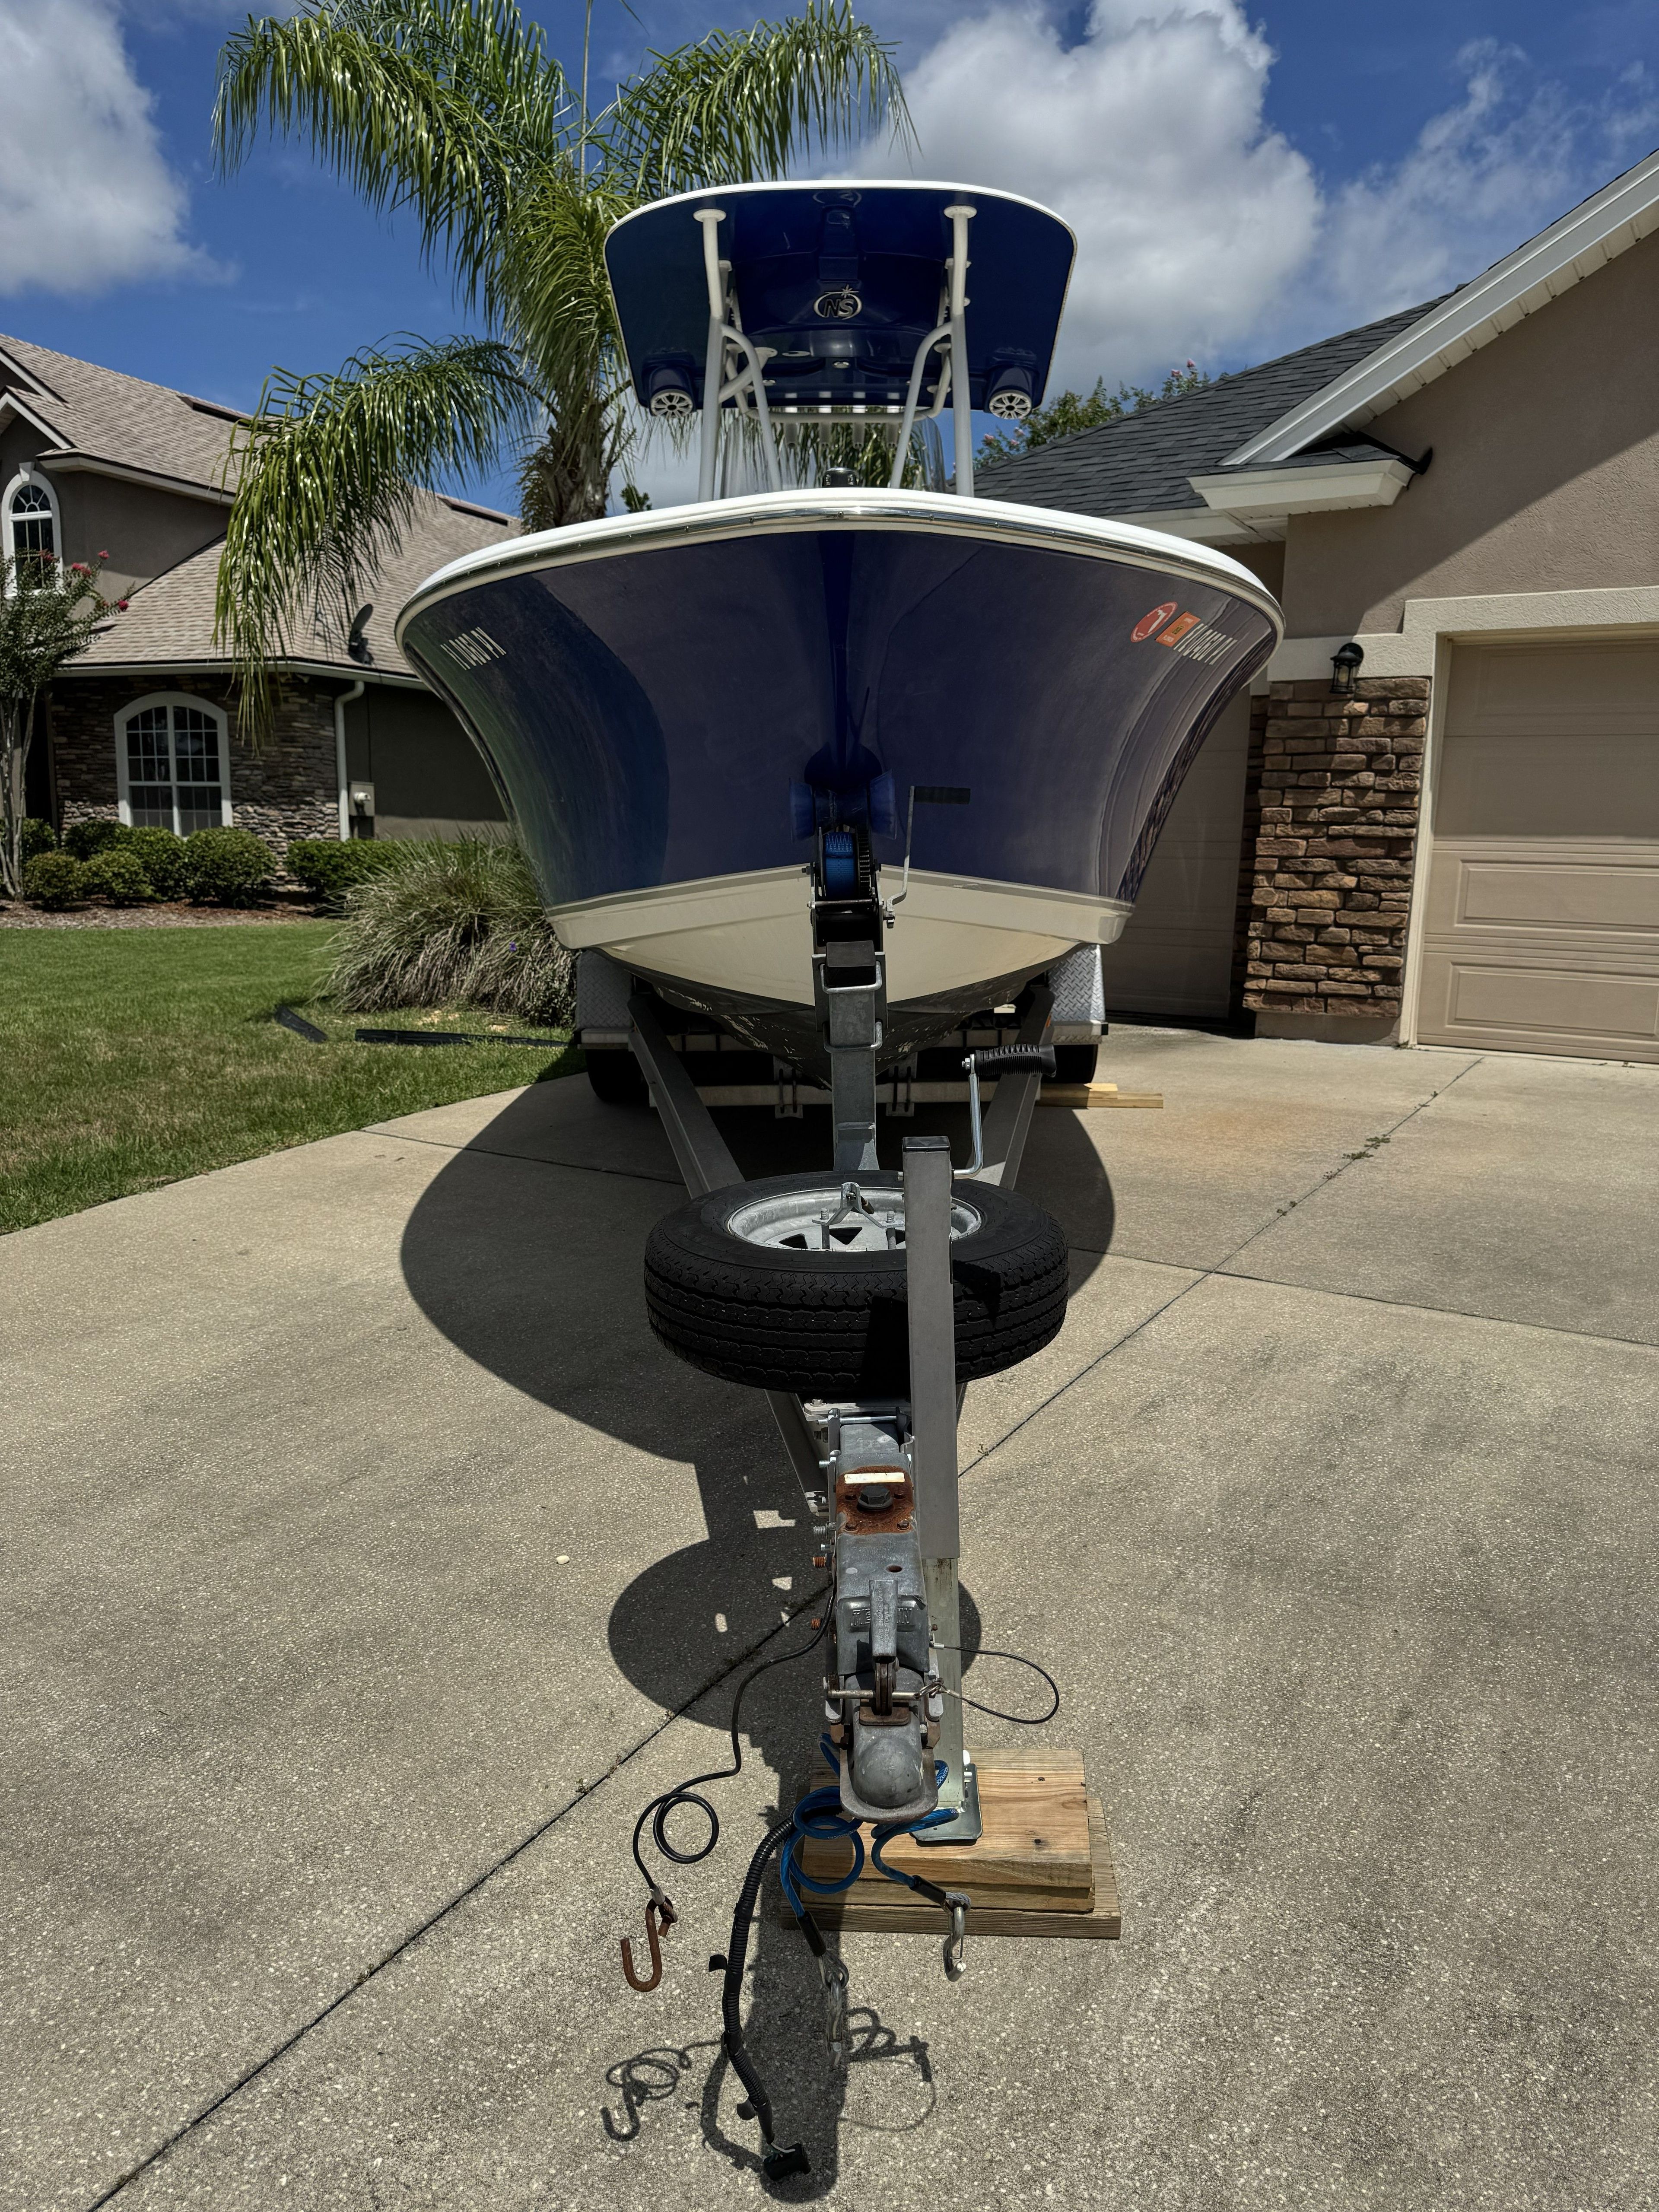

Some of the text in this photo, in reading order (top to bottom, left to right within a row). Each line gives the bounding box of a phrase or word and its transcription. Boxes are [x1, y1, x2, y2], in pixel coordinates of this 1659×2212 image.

[823, 299, 854, 318] NS
[448, 633, 492, 666] 0460
[1173, 623, 1208, 652] FL
[1182, 629, 1227, 661] 0460
[440, 643, 471, 671] FL
